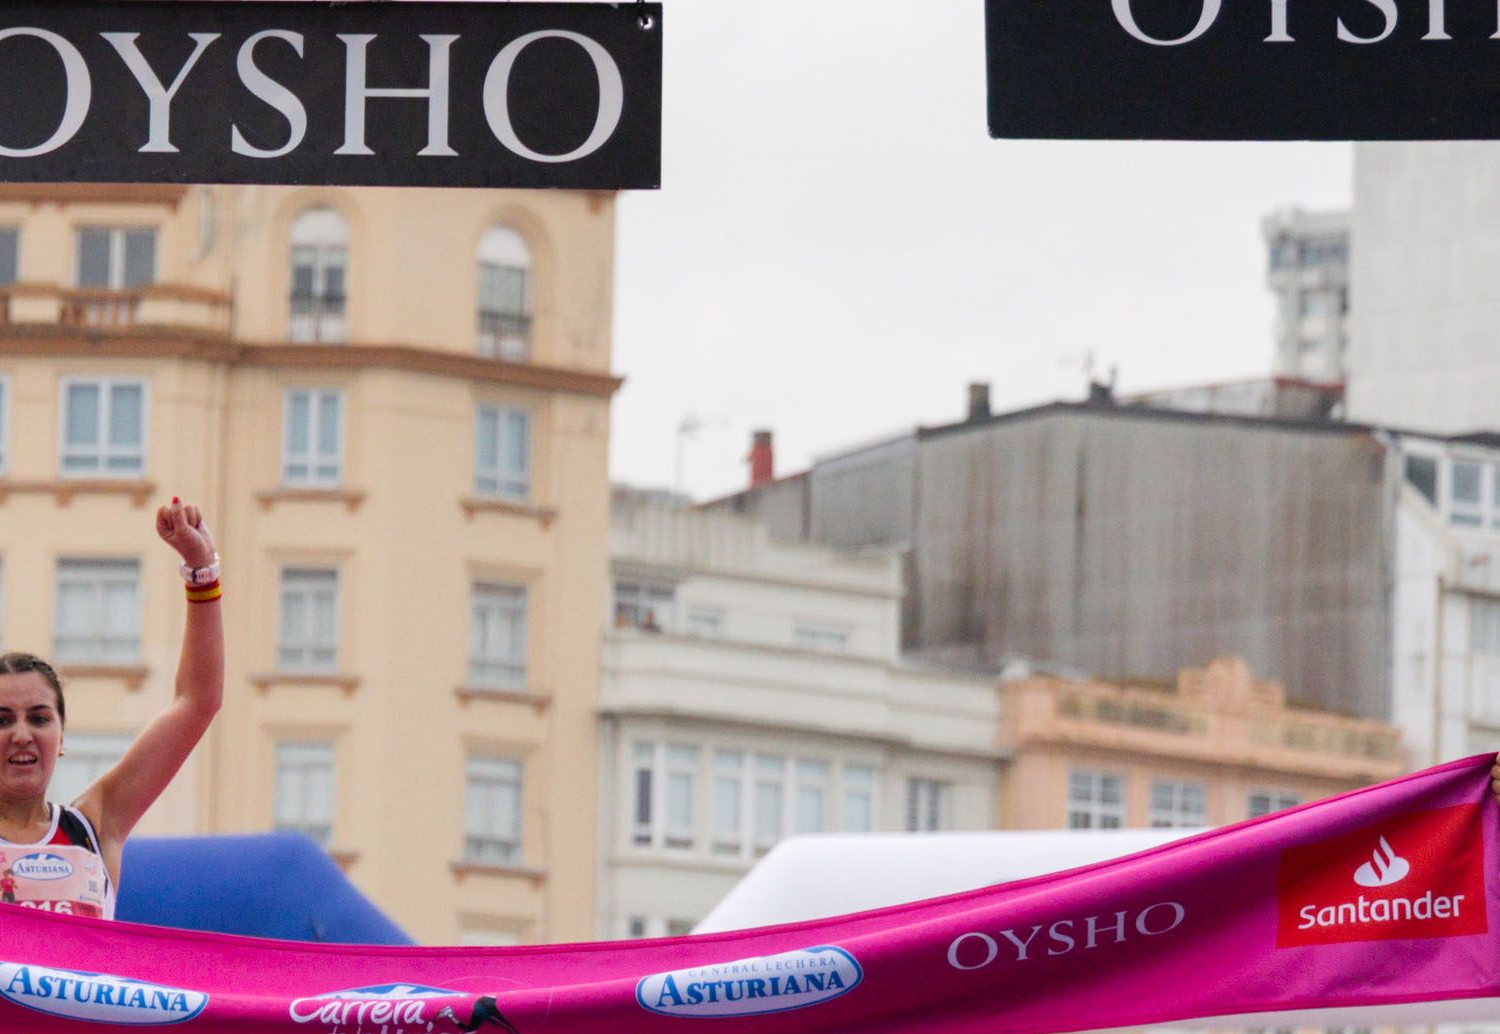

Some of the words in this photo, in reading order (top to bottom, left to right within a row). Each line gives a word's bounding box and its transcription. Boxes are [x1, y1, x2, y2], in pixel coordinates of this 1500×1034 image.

[16, 862, 70, 874] ASTURIANA
[1298, 890, 1466, 930] Santander
[947, 901, 1186, 971] OYSHO
[688, 963, 759, 977] CENTRAL
[765, 957, 837, 972] LECHERA
[5, 966, 190, 1012] ASTURIANA
[655, 969, 846, 1008] ASTURIANA
[289, 998, 426, 1024] Carrera
